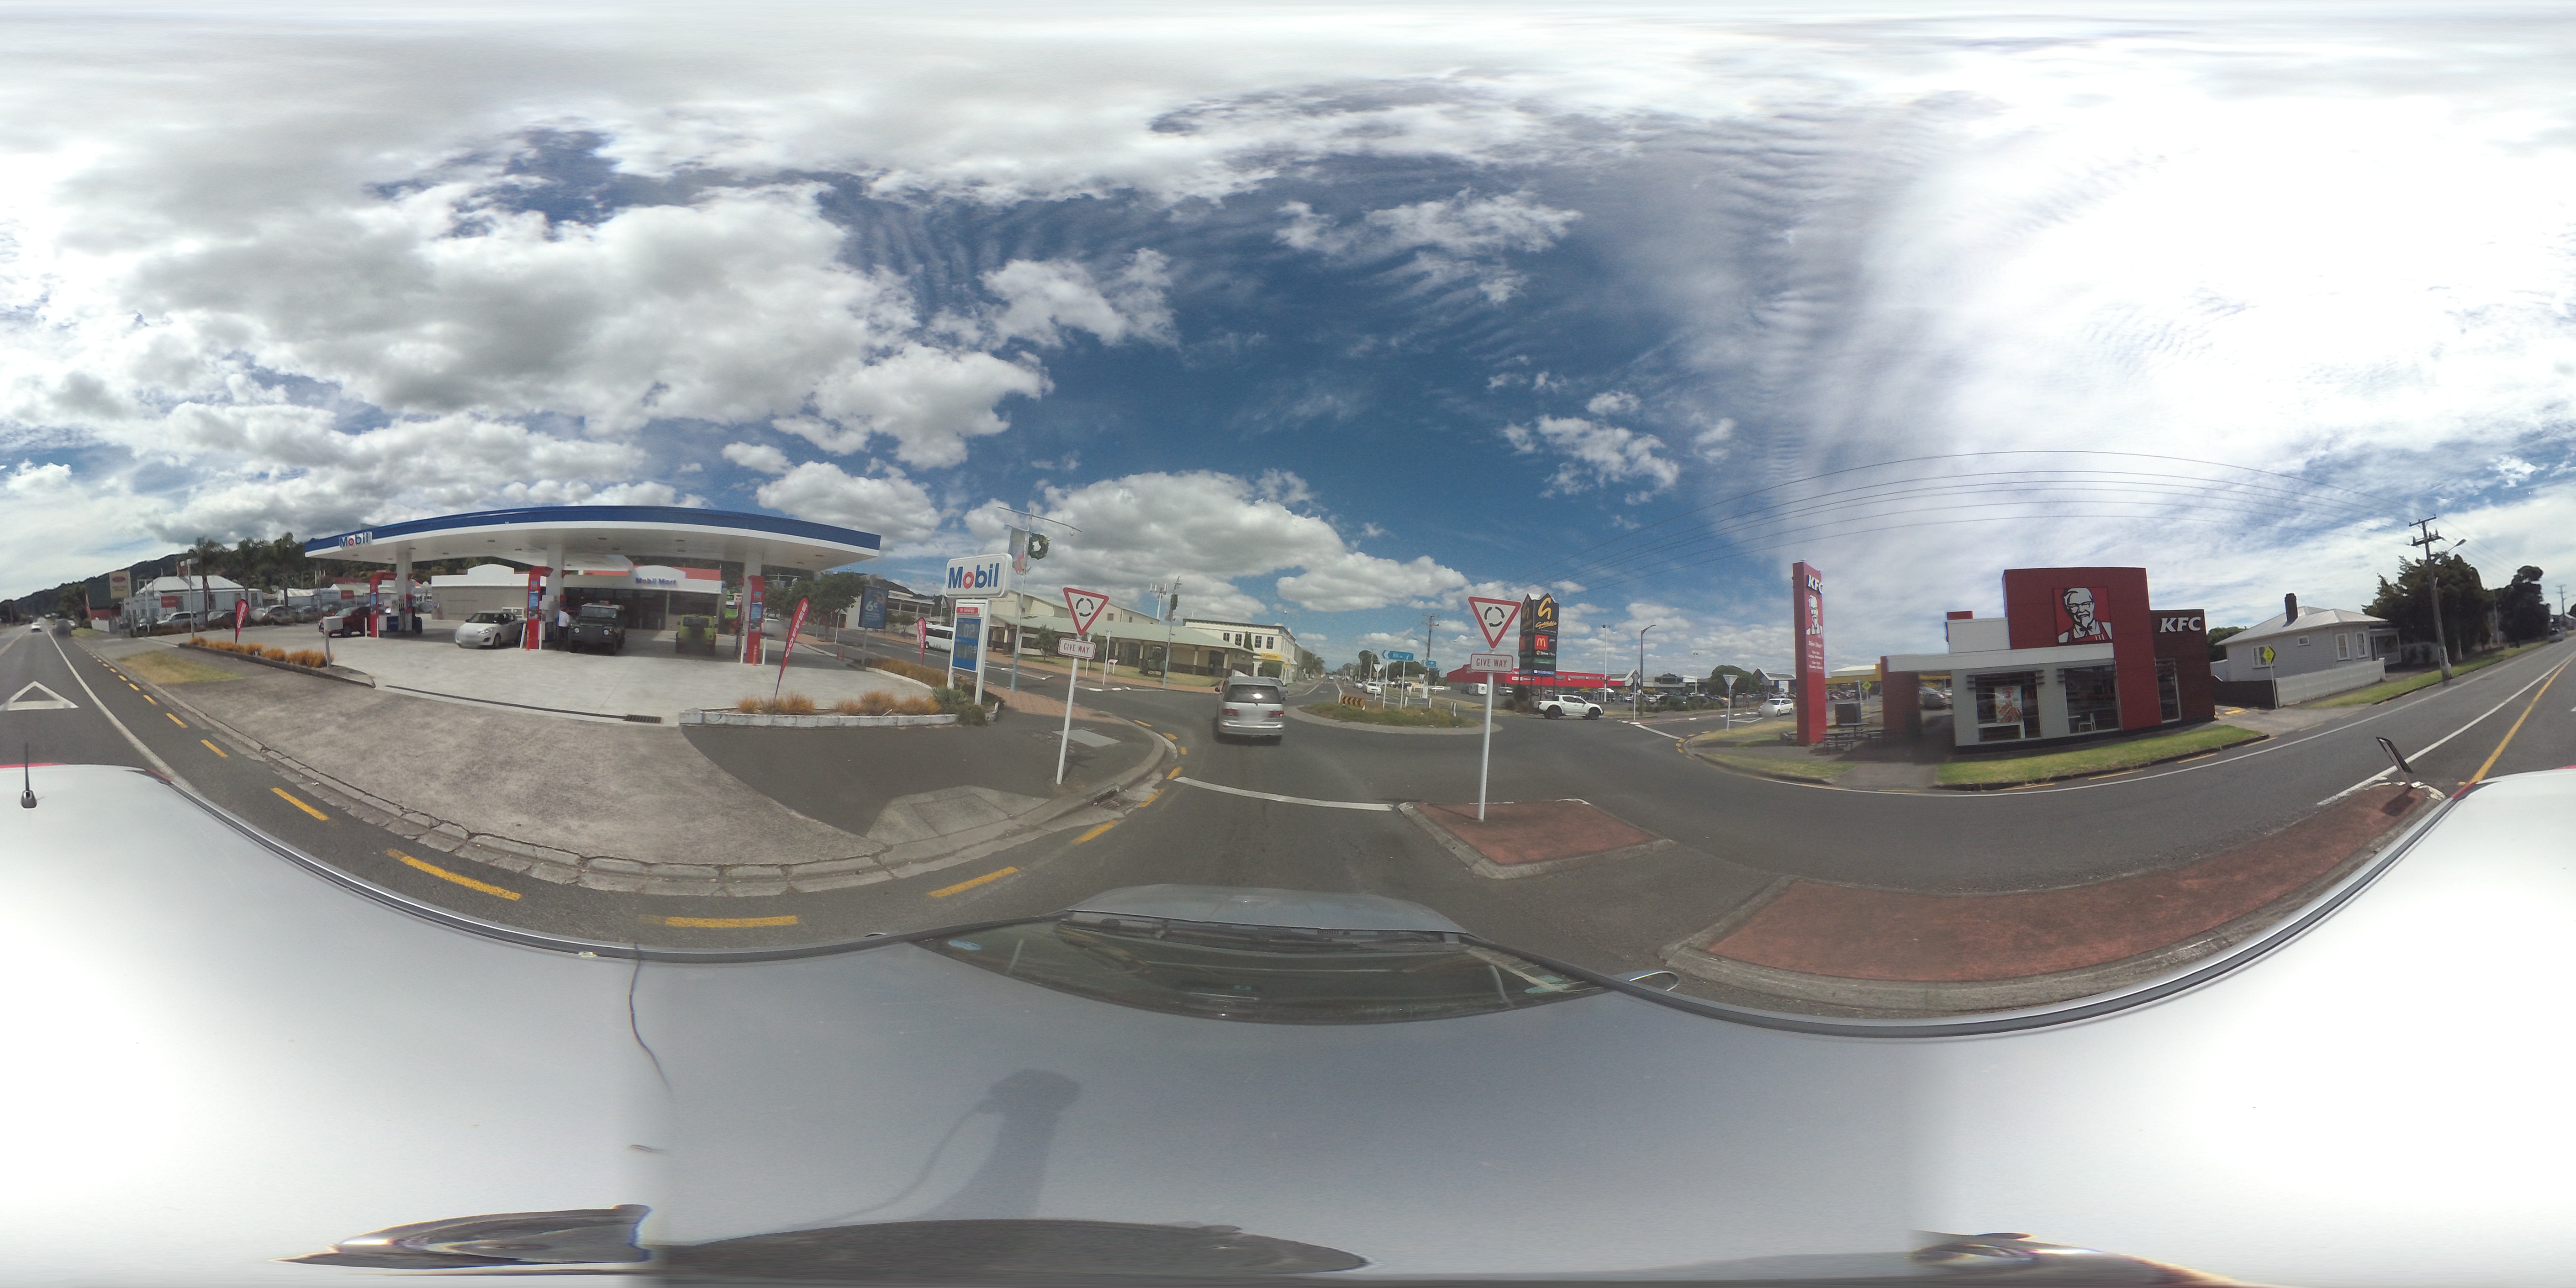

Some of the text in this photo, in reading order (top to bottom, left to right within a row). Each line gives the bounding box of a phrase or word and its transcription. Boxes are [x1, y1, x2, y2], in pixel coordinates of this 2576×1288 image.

[340, 532, 368, 547] Mobil
[948, 563, 999, 589] Mobil
[1807, 575, 1823, 594] KFC
[786, 602, 808, 658] COFFEE
[2159, 617, 2201, 633] KFC
[1064, 643, 1090, 654] GIVE WAY
[1476, 658, 1507, 667] GIVE WAY
